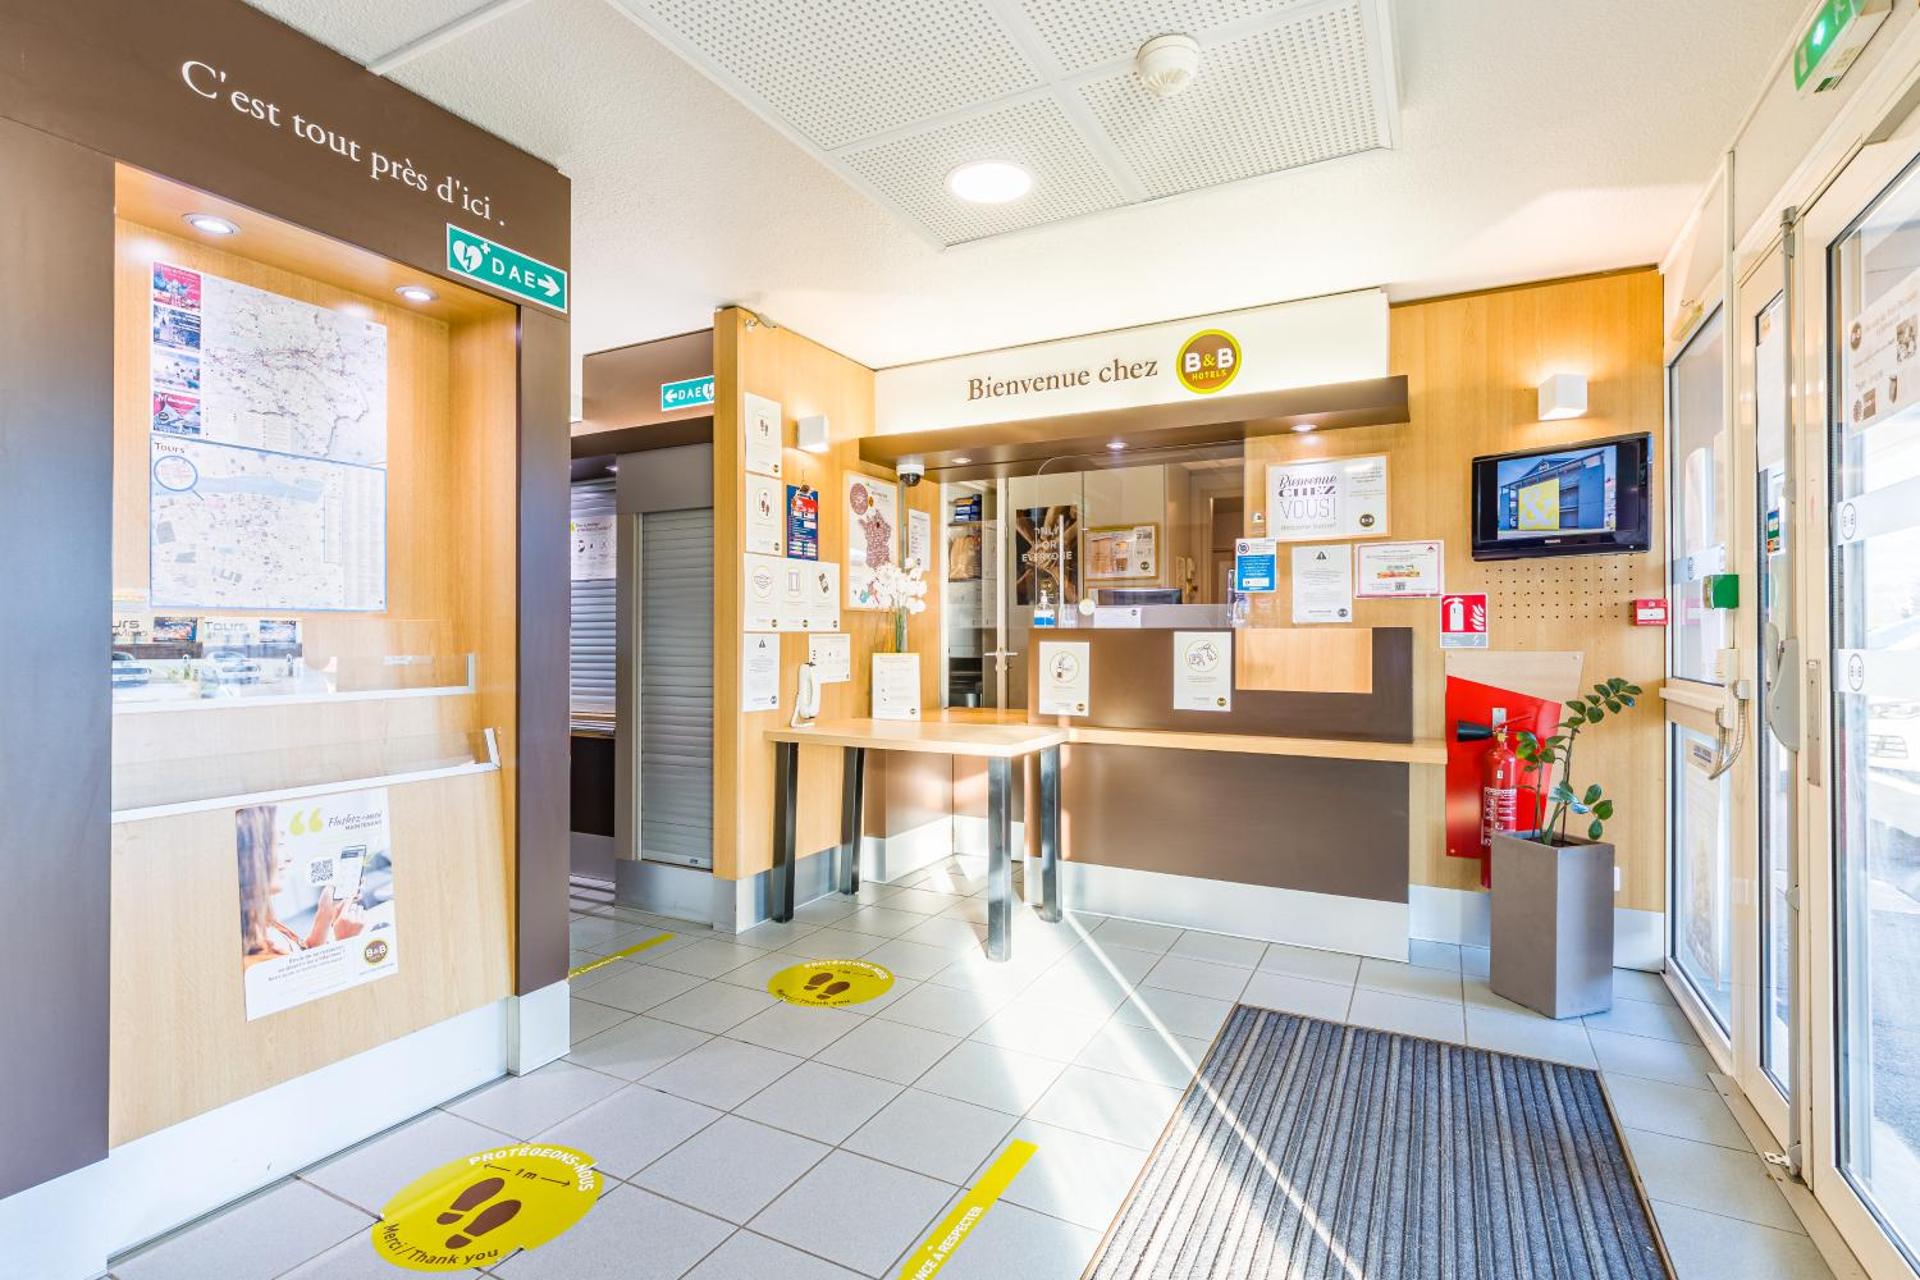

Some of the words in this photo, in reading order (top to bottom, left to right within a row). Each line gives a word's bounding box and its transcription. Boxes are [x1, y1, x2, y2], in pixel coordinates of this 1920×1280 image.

[181, 60, 281, 127] C'est
[292, 114, 360, 163] tout
[369, 151, 429, 193] près
[491, 257, 536, 289] DAE
[677, 386, 702, 401] DAE
[967, 366, 1091, 402] Bienvenue
[1099, 357, 1159, 383] chez
[1191, 369, 1228, 382] HOTELS
[154, 442, 186, 454] Tours
[382, 1222, 404, 1252] Merci
[407, 1248, 460, 1266] Thank
[464, 1248, 500, 1266] you
[911, 1258, 938, 1280] NCE
[937, 1206, 984, 1255] RESPECTER
